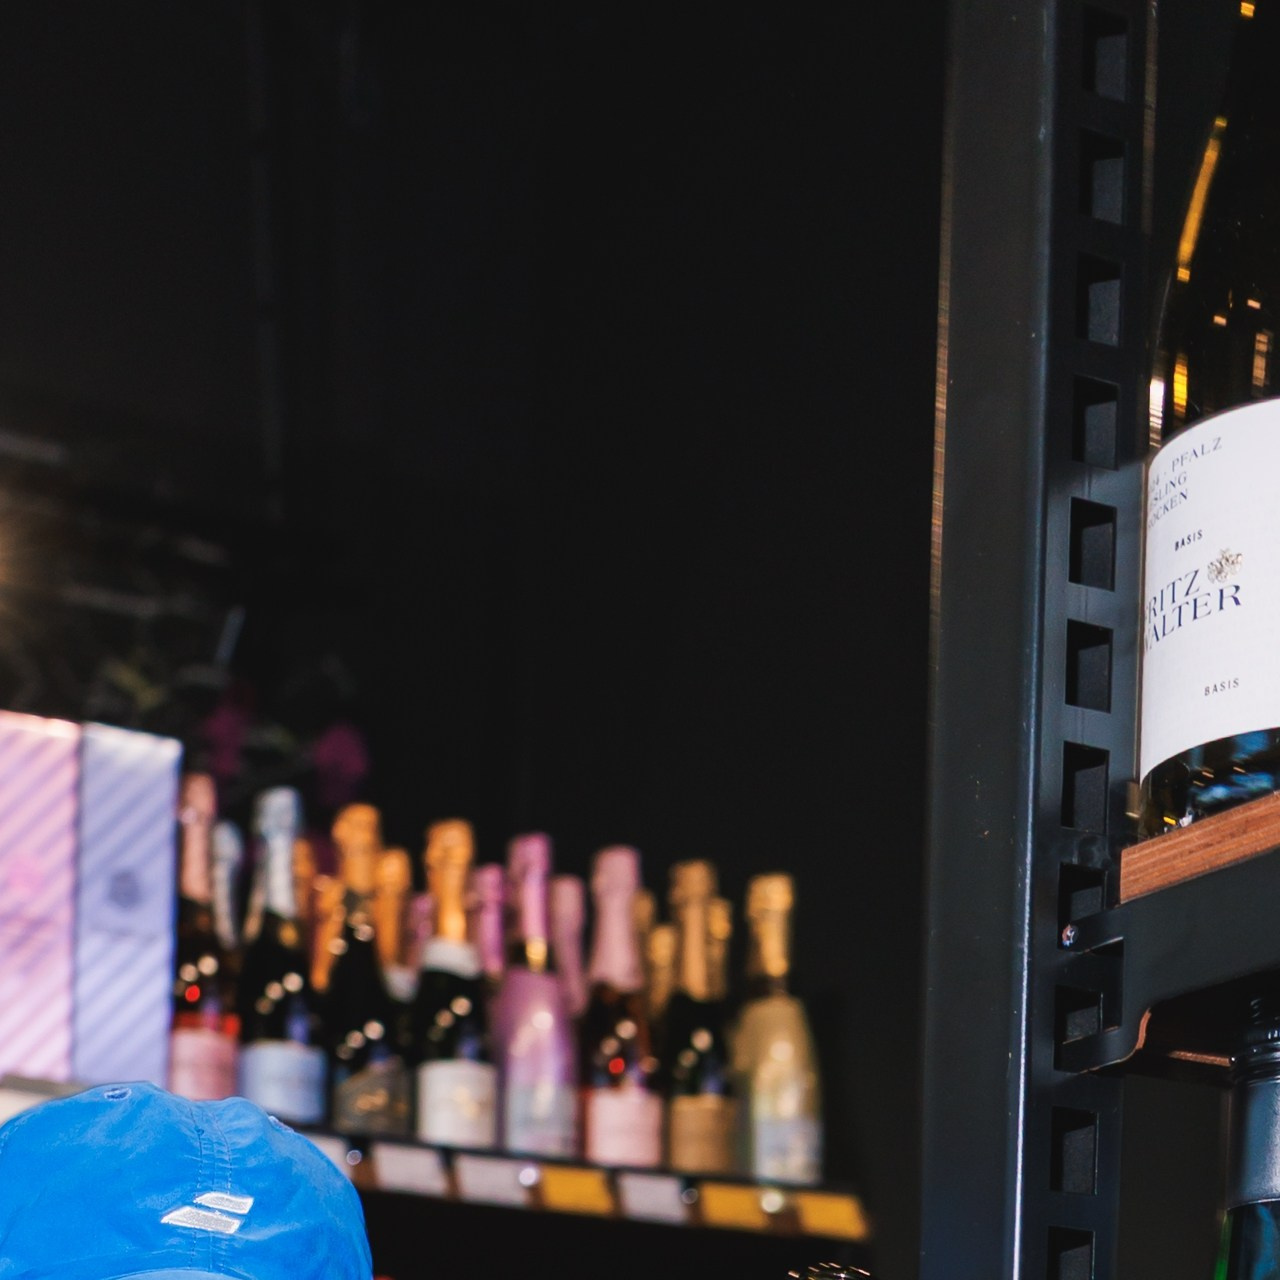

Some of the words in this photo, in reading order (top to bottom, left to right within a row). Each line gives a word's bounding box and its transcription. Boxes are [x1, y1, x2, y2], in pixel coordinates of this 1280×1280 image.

[1171, 436, 1222, 473] PFALZ
[1174, 529, 1203, 551] BASIS
[1204, 677, 1240, 697] BASIS
